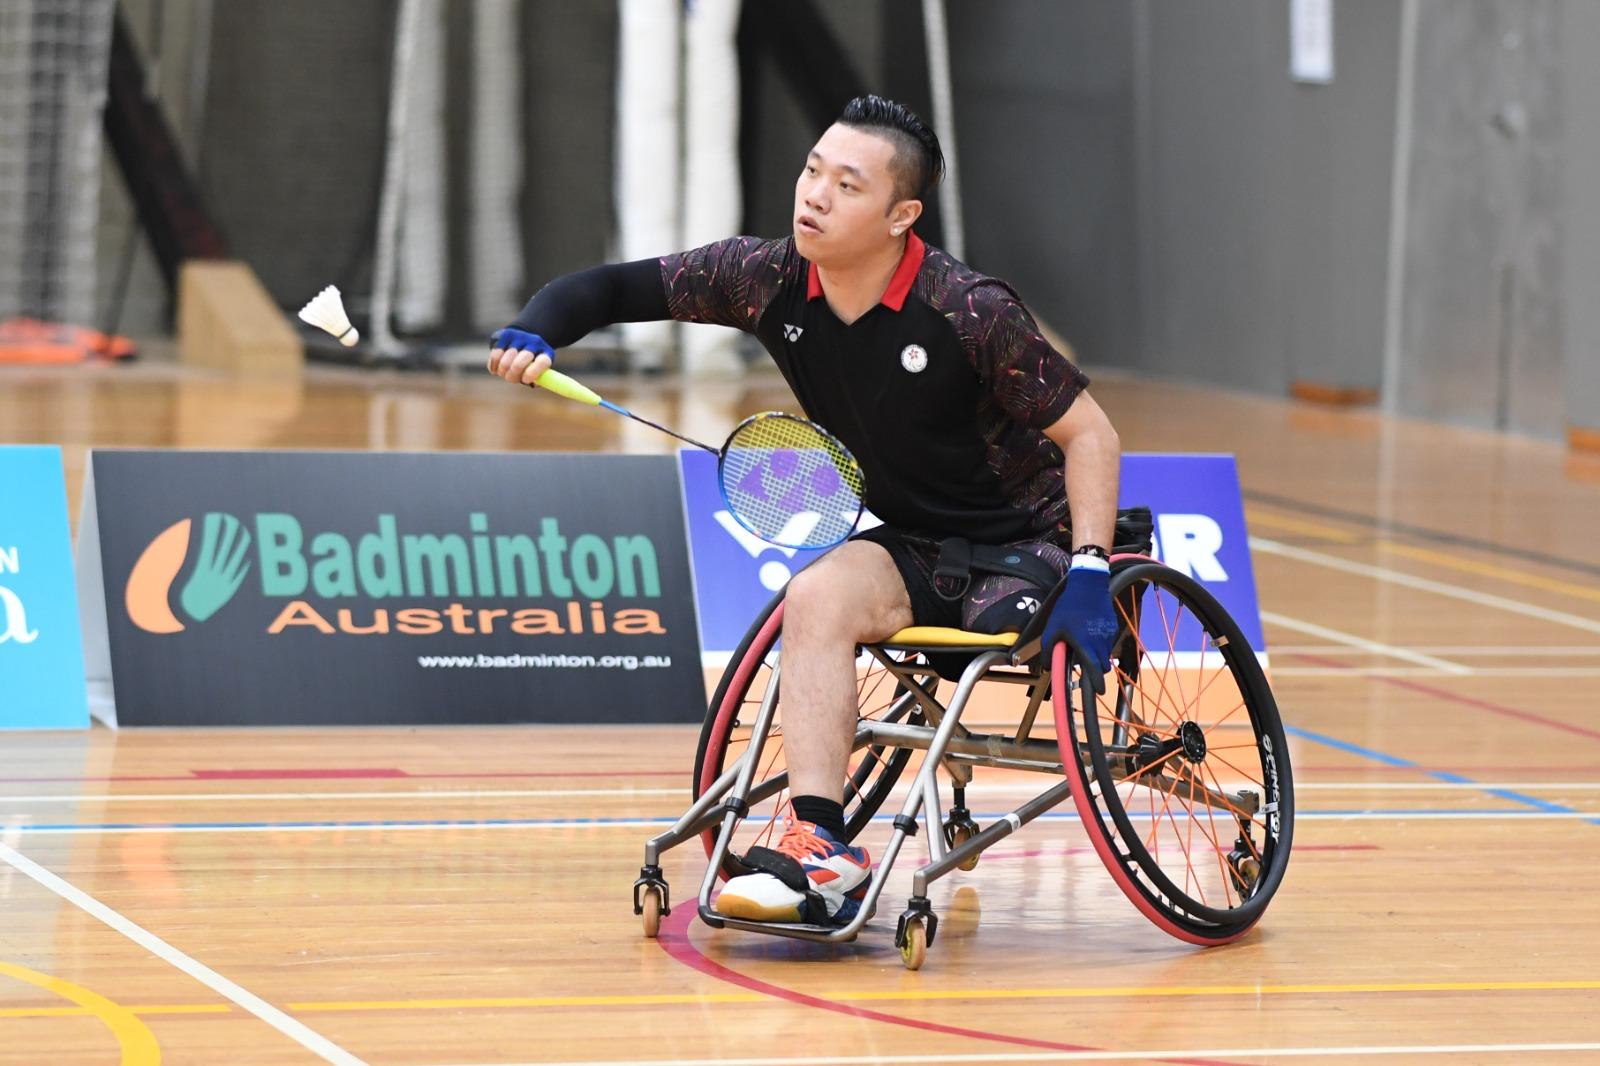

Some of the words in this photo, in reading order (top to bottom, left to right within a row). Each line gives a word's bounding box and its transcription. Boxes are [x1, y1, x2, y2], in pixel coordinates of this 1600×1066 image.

[255, 512, 661, 599] Badminton
[267, 600, 667, 635] Australia
[418, 653, 672, 671] www.badminton.org.au
